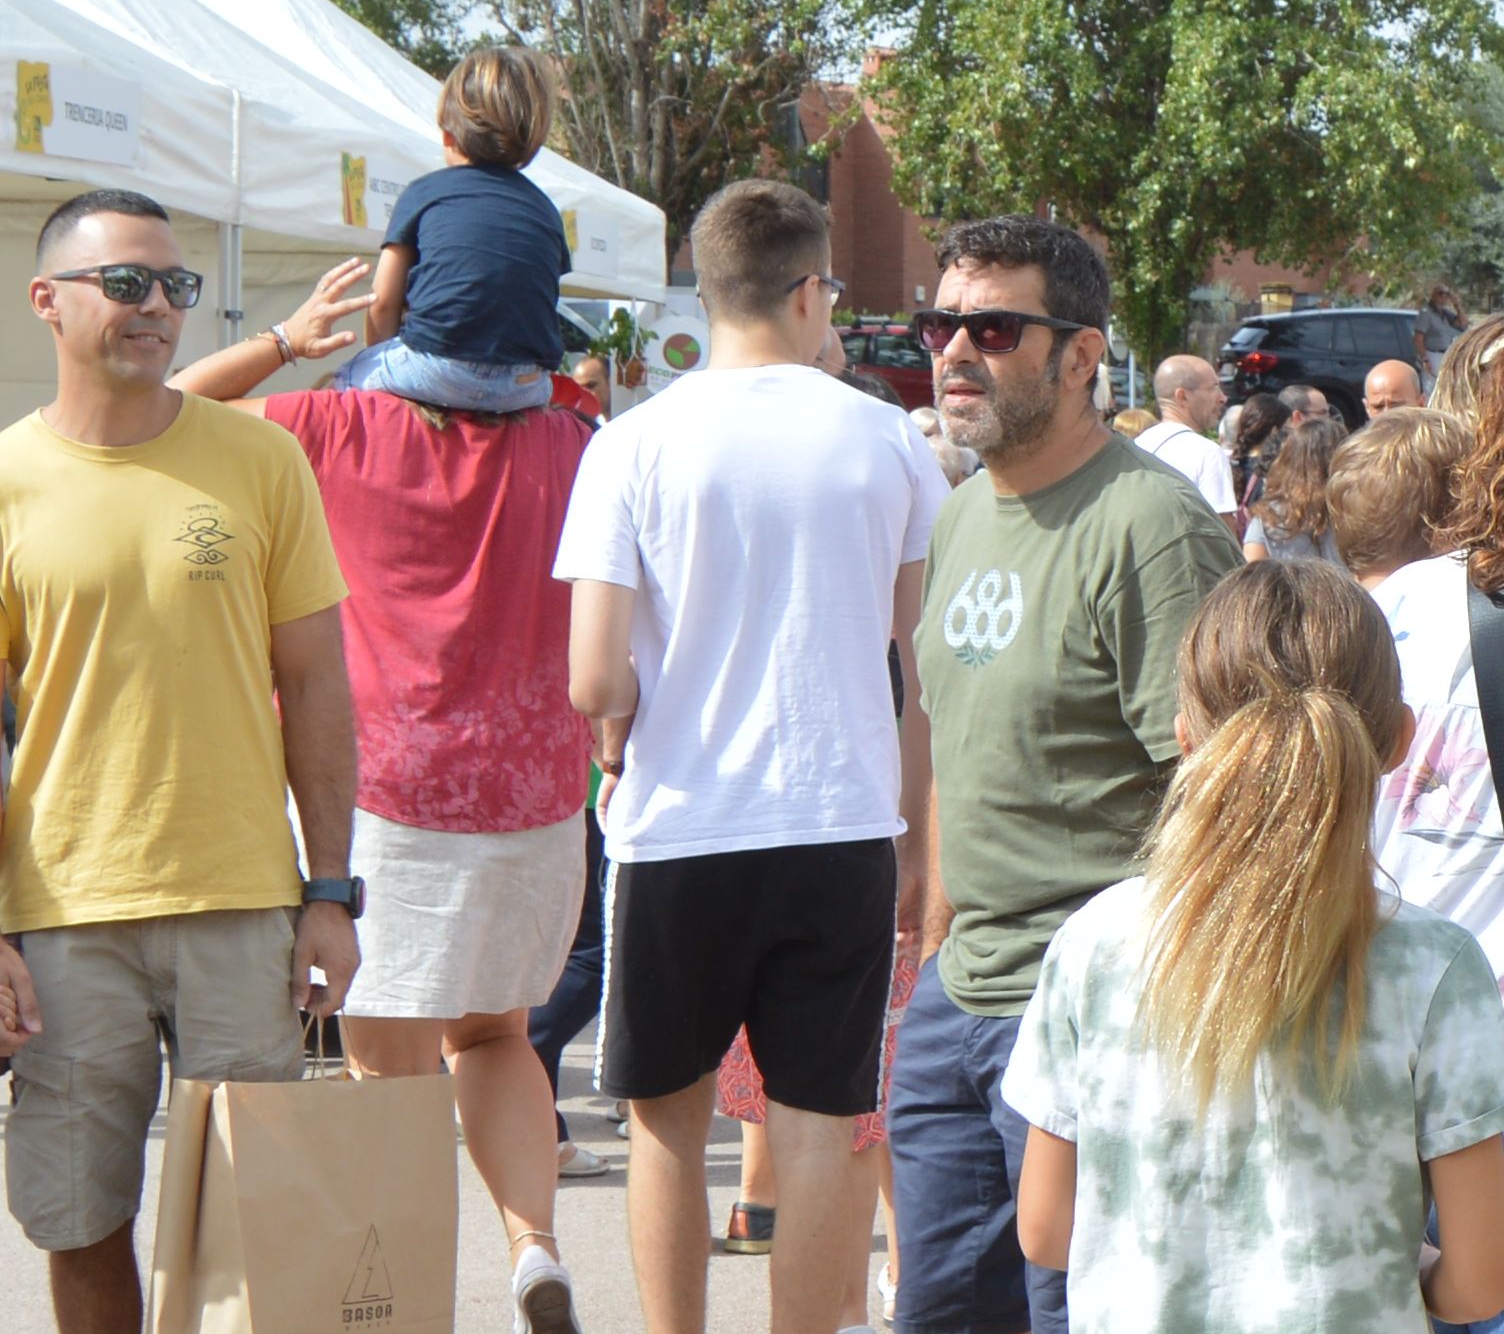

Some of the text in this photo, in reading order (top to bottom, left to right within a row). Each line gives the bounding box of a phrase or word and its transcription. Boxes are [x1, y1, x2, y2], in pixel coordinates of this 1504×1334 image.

[188, 569, 225, 582] RIP CURL
[342, 1303, 393, 1324] BASOA
